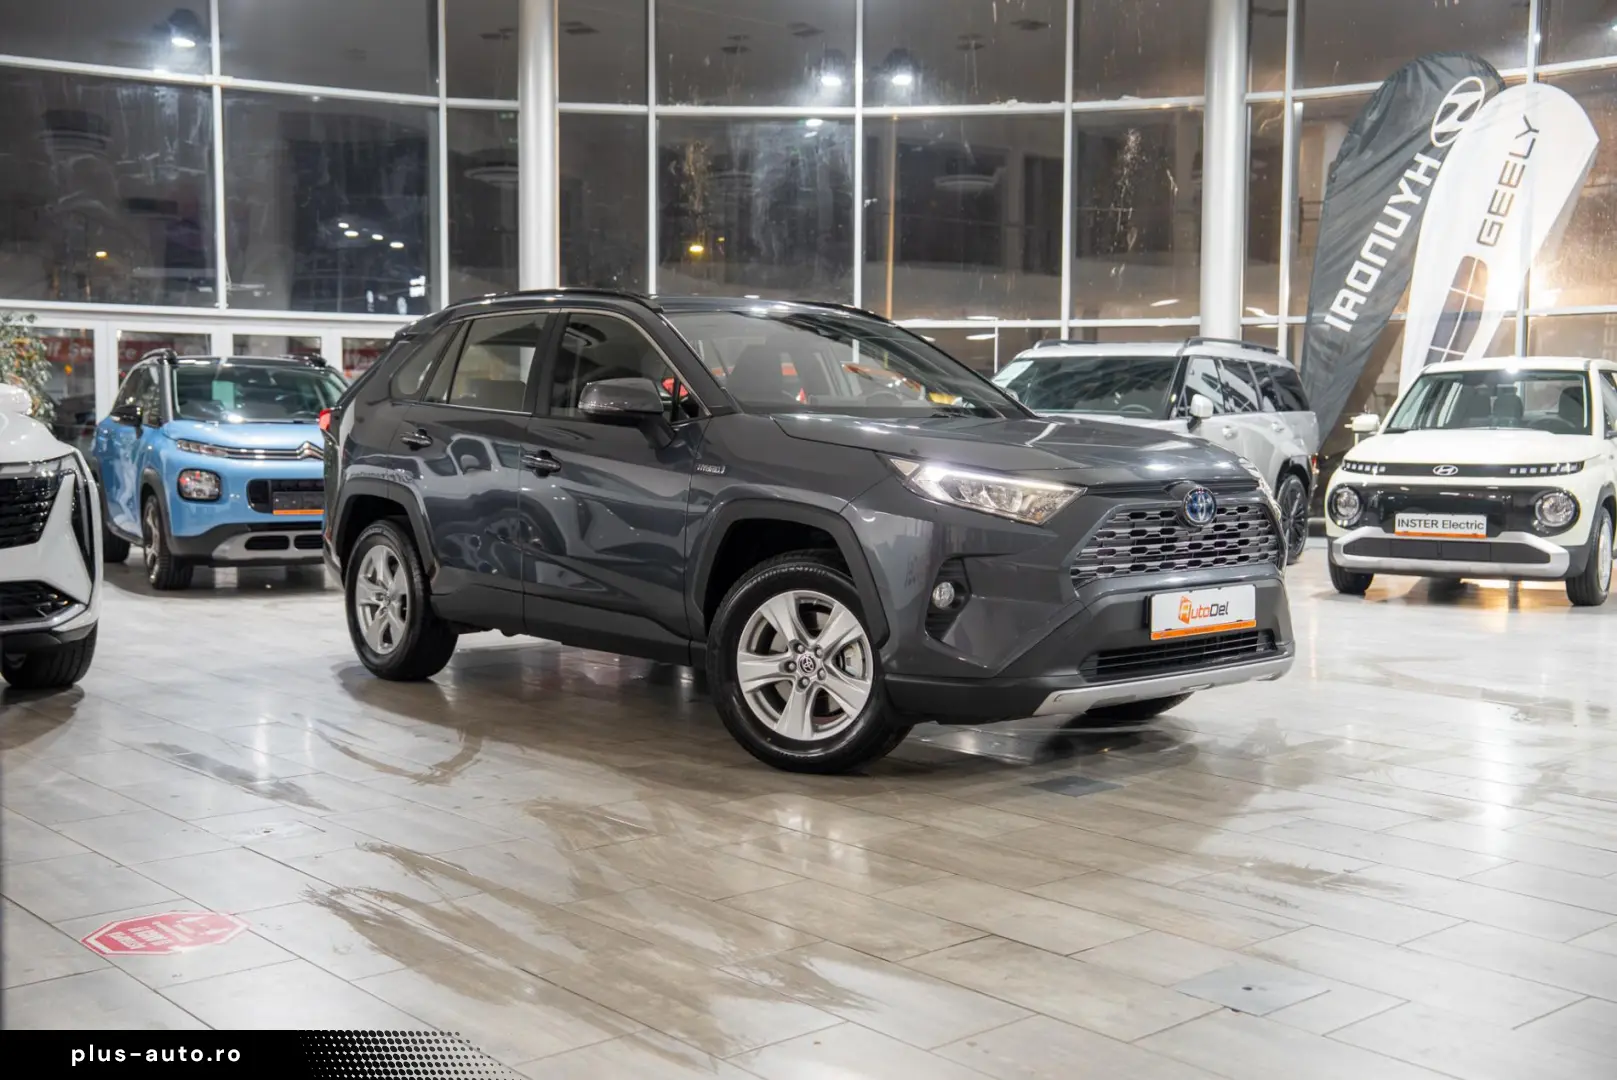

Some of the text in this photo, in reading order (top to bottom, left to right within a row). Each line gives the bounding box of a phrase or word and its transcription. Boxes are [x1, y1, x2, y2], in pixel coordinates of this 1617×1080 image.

[1476, 114, 1540, 247] GEELY
[1397, 518, 1485, 531] INSTER Electric
[1178, 595, 1230, 625] AutoDel
